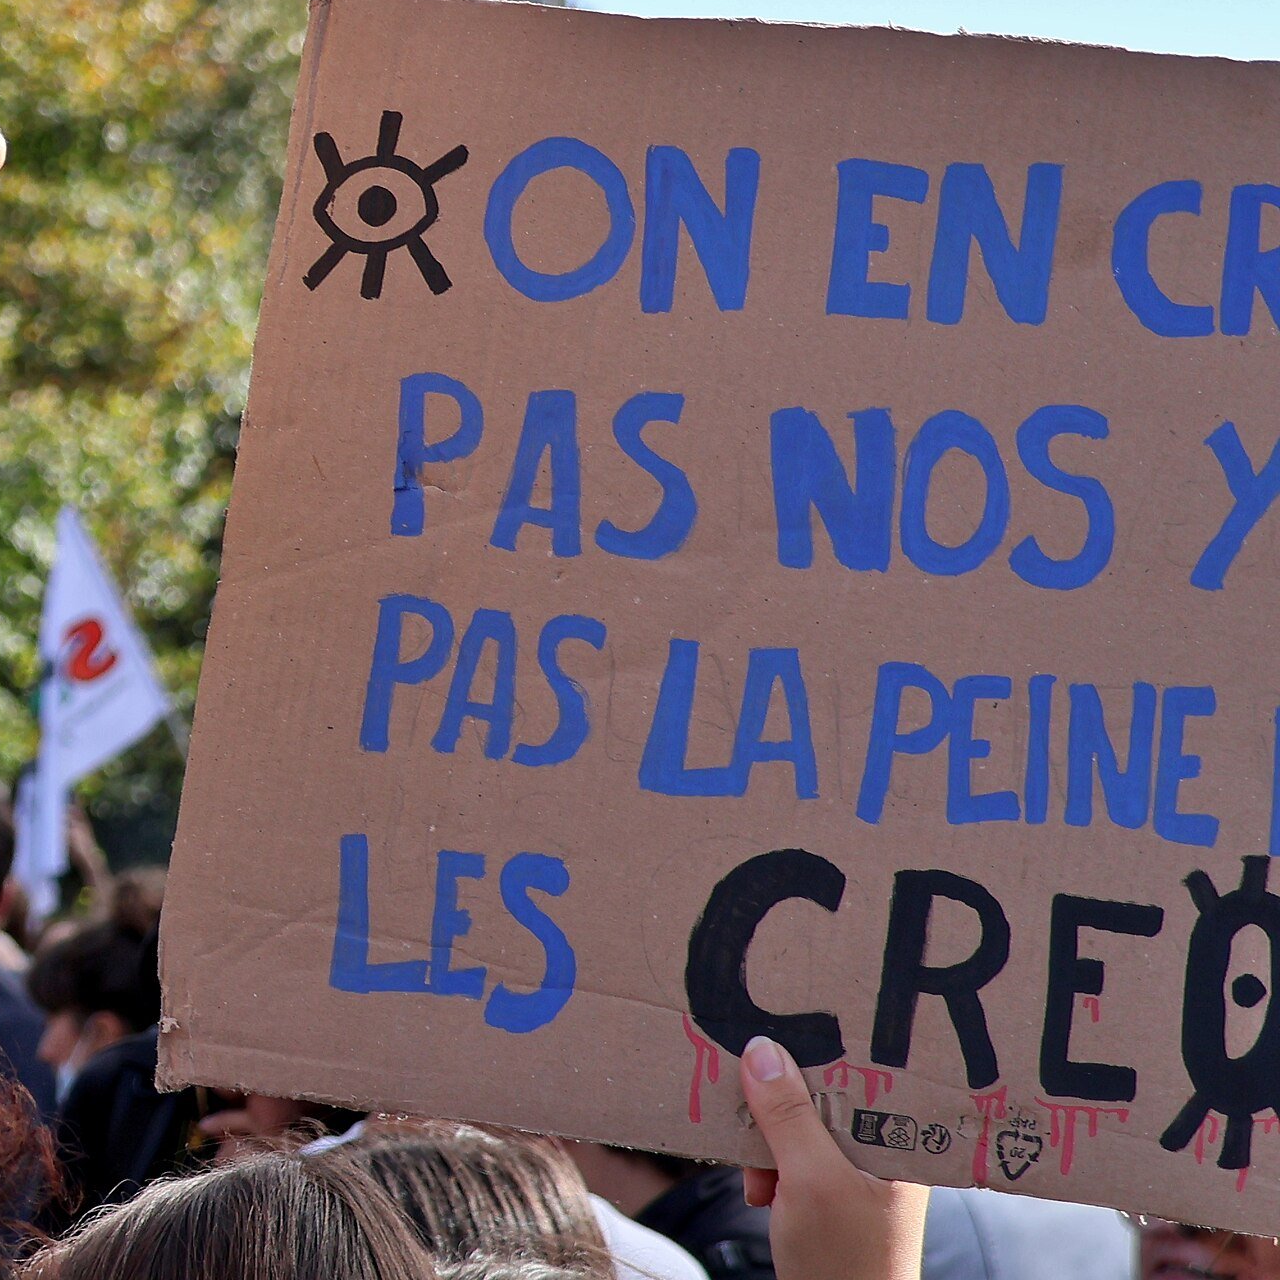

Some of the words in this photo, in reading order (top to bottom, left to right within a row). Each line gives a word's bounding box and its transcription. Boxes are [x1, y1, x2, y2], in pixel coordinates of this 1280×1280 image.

[484, 137, 761, 313] ON
[826, 158, 1063, 326] EN
[391, 373, 698, 560] PAS
[770, 405, 1115, 590] NOS
[360, 595, 607, 767] PAS
[638, 638, 818, 800] LA
[856, 662, 1220, 848] PEINE
[330, 834, 576, 1033] LES
